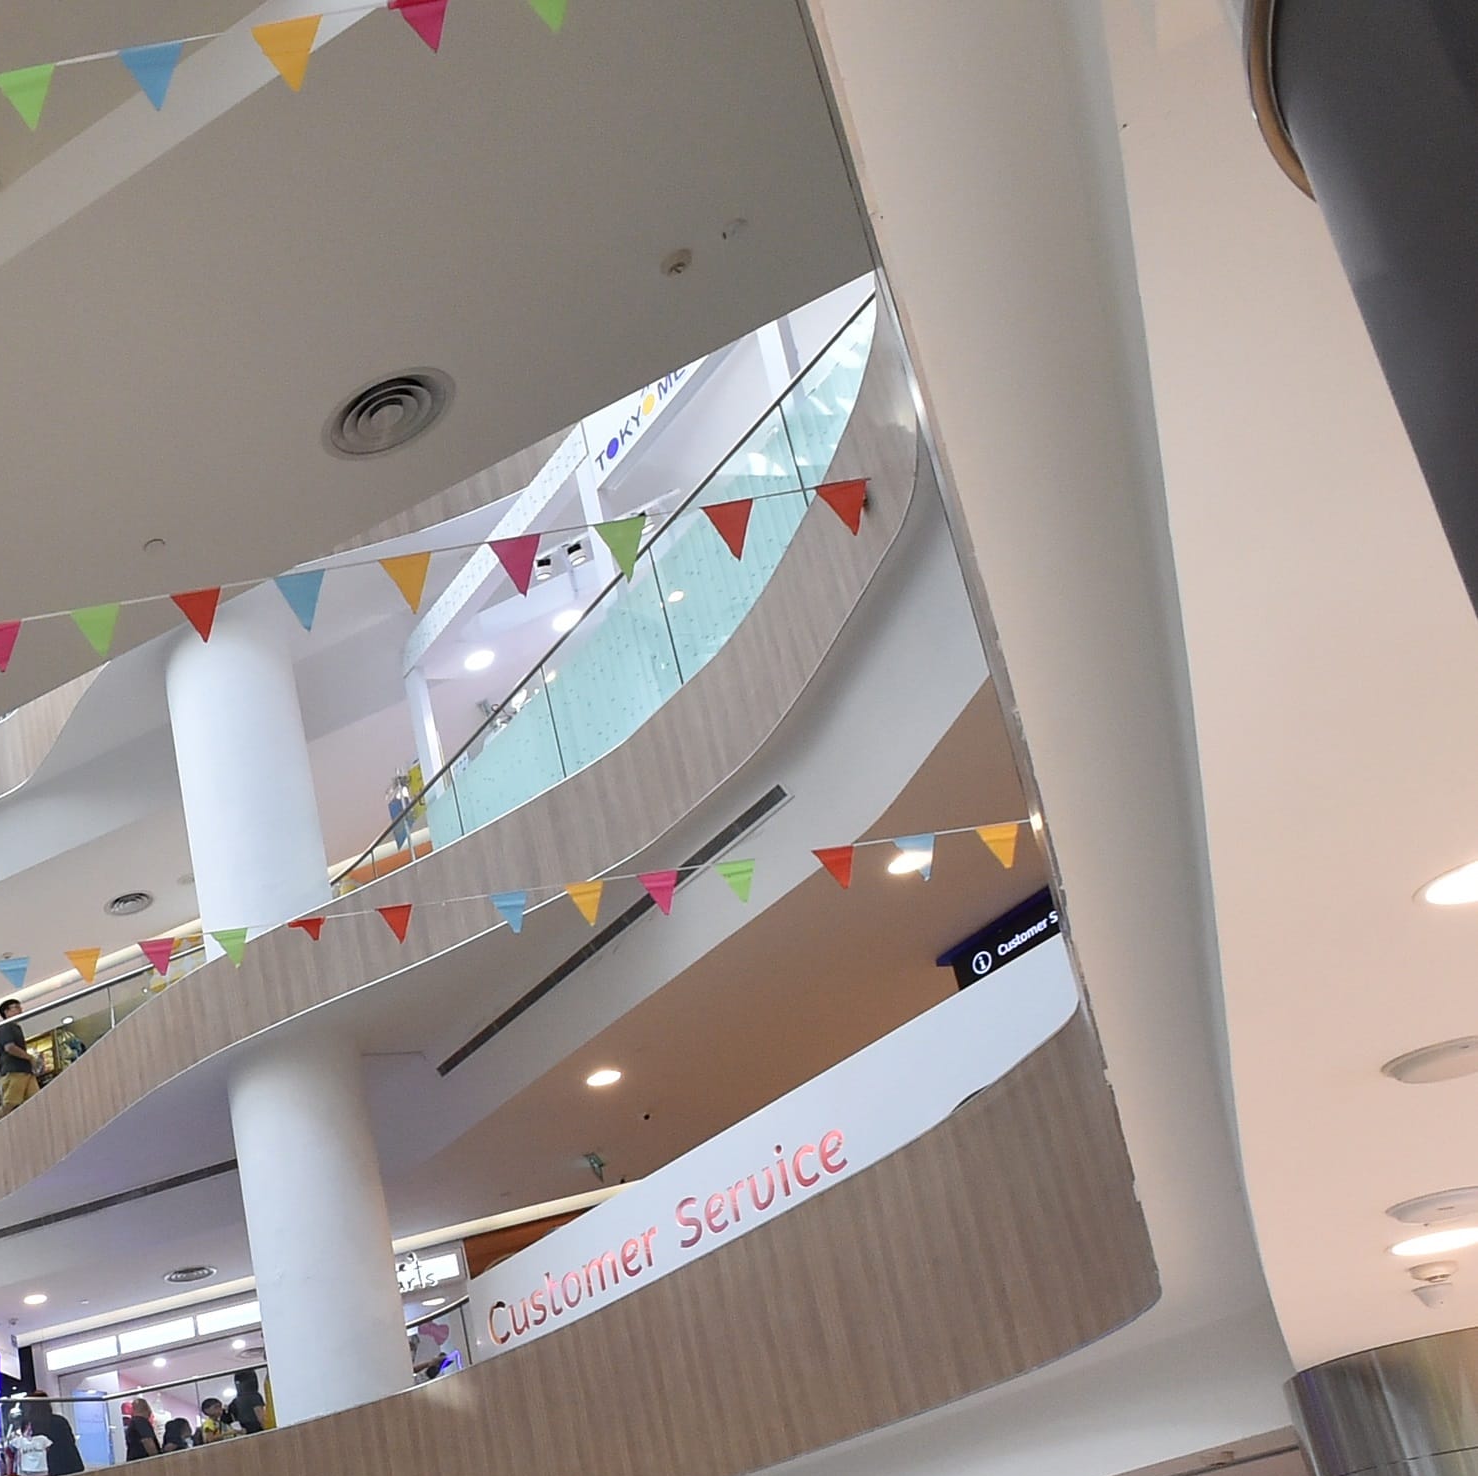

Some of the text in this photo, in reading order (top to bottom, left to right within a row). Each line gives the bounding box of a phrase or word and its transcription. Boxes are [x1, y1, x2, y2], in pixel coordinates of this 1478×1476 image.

[997, 918, 1049, 956] Customer
[487, 1129, 848, 1345] Customer Service
